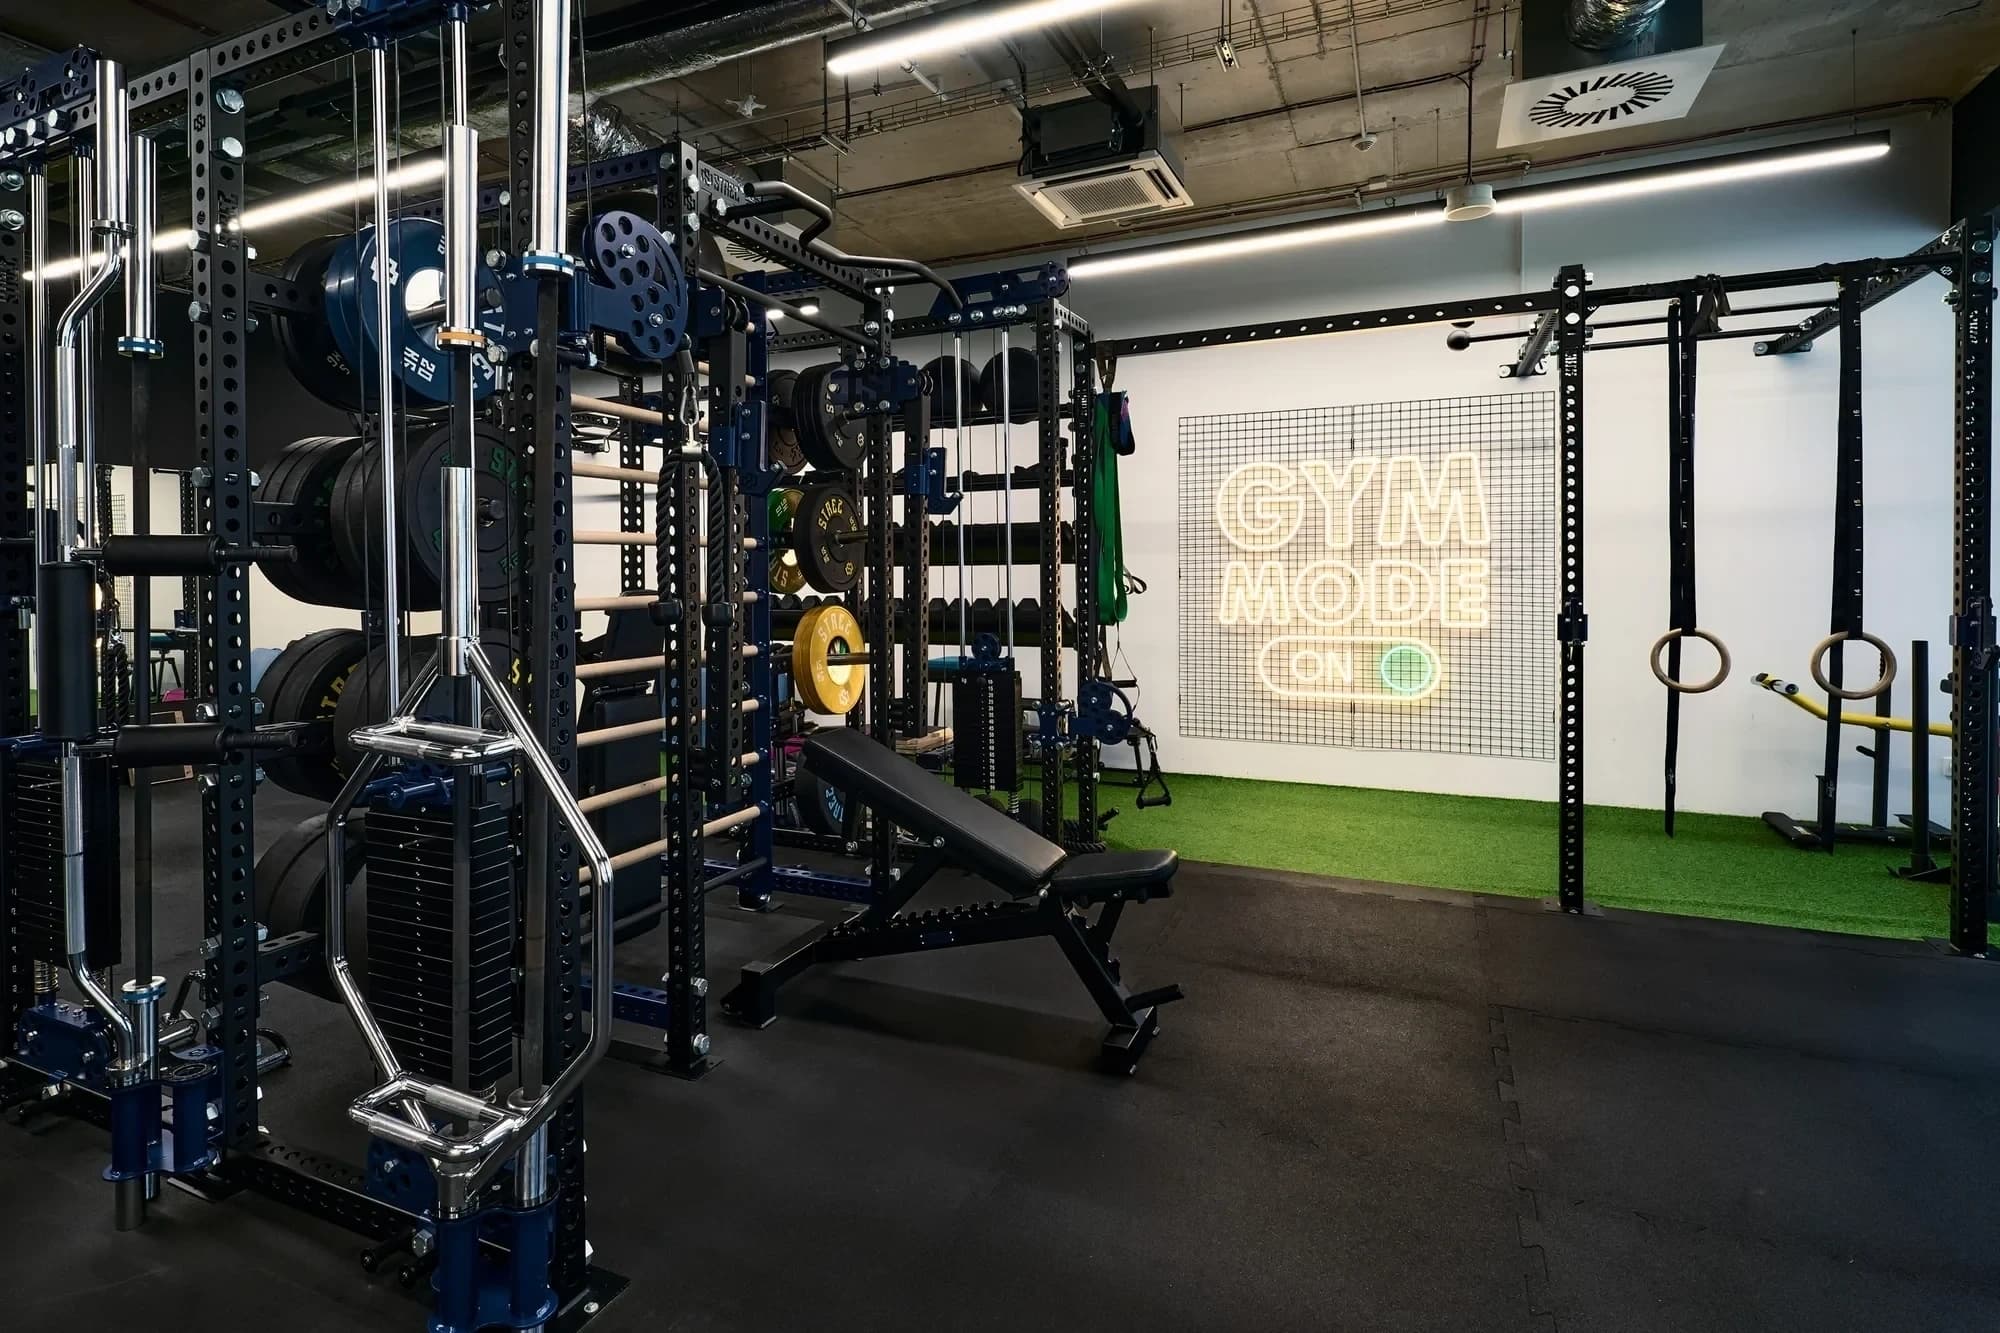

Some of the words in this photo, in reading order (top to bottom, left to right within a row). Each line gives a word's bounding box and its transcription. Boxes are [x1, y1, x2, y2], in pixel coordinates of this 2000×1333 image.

[418, 357, 436, 383] 20
[1215, 452, 1491, 552] GYM
[1218, 557, 1489, 629] MODE
[1291, 649, 1352, 684] ON
